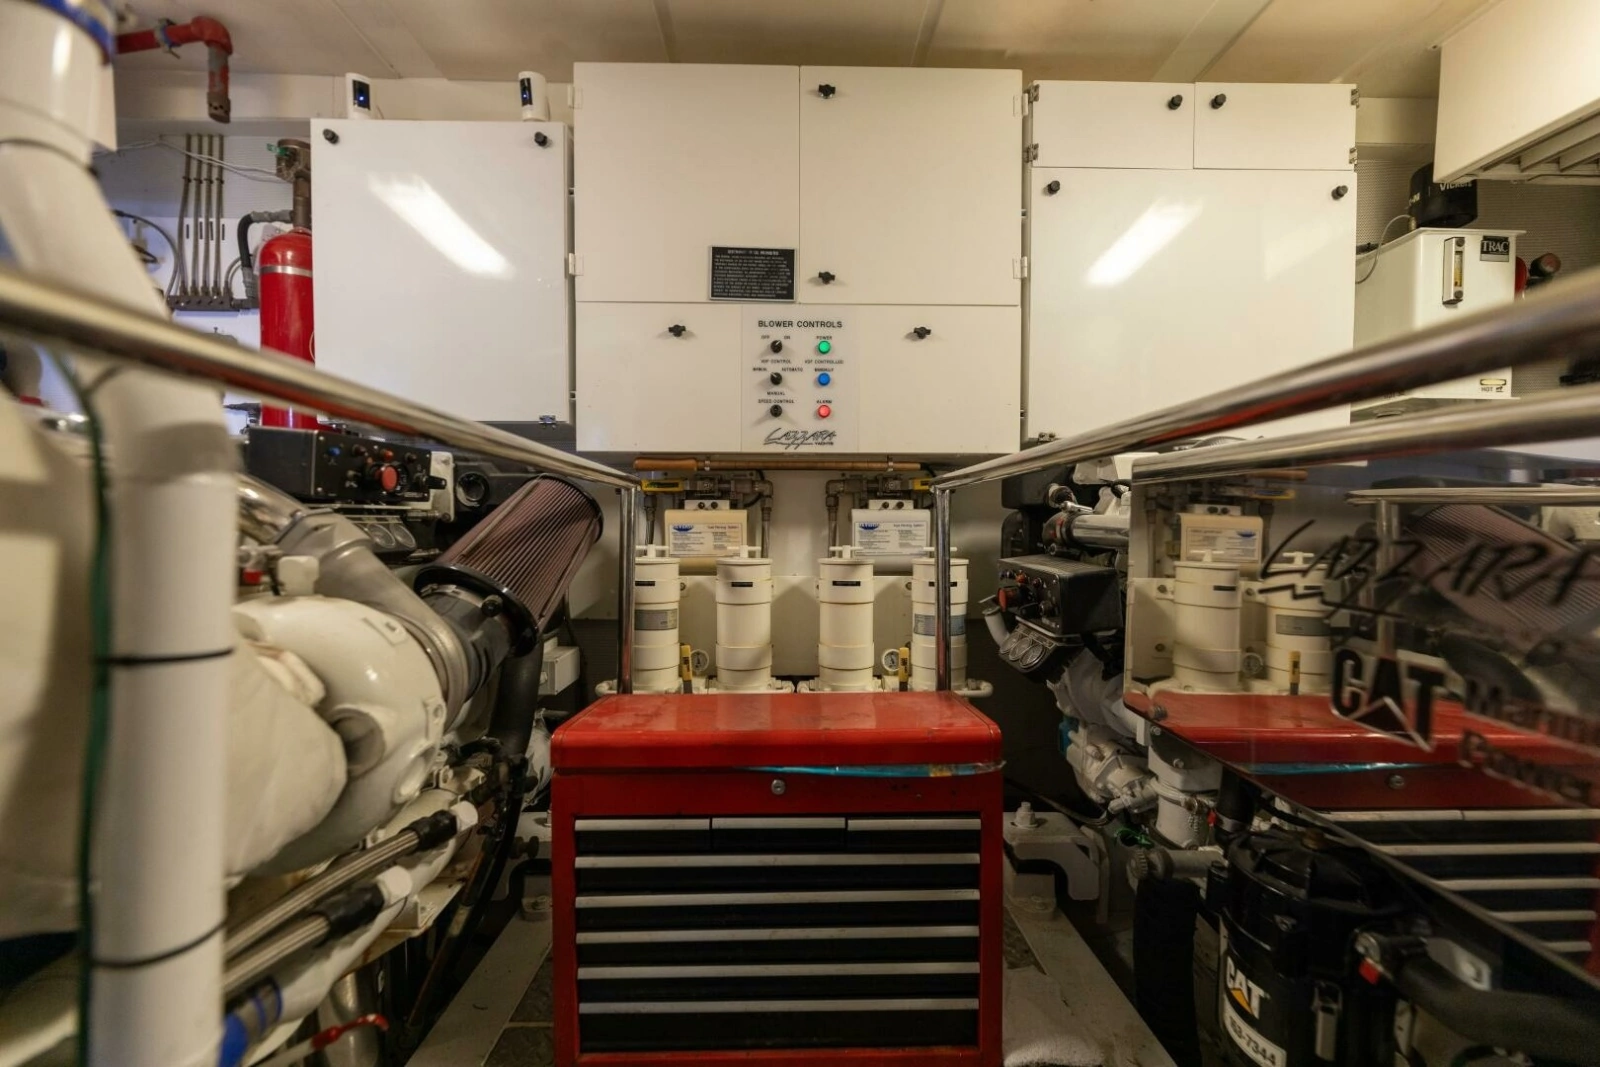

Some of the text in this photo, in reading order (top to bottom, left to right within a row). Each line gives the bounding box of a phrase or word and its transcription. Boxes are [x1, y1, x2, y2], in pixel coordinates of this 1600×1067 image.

[1482, 241, 1509, 252] TRAC
[758, 320, 843, 329] BLOWER CONTROLS
[763, 427, 837, 450] LAZZARA
[1332, 649, 1448, 751] CAT
[1226, 956, 1268, 1019] CAT
